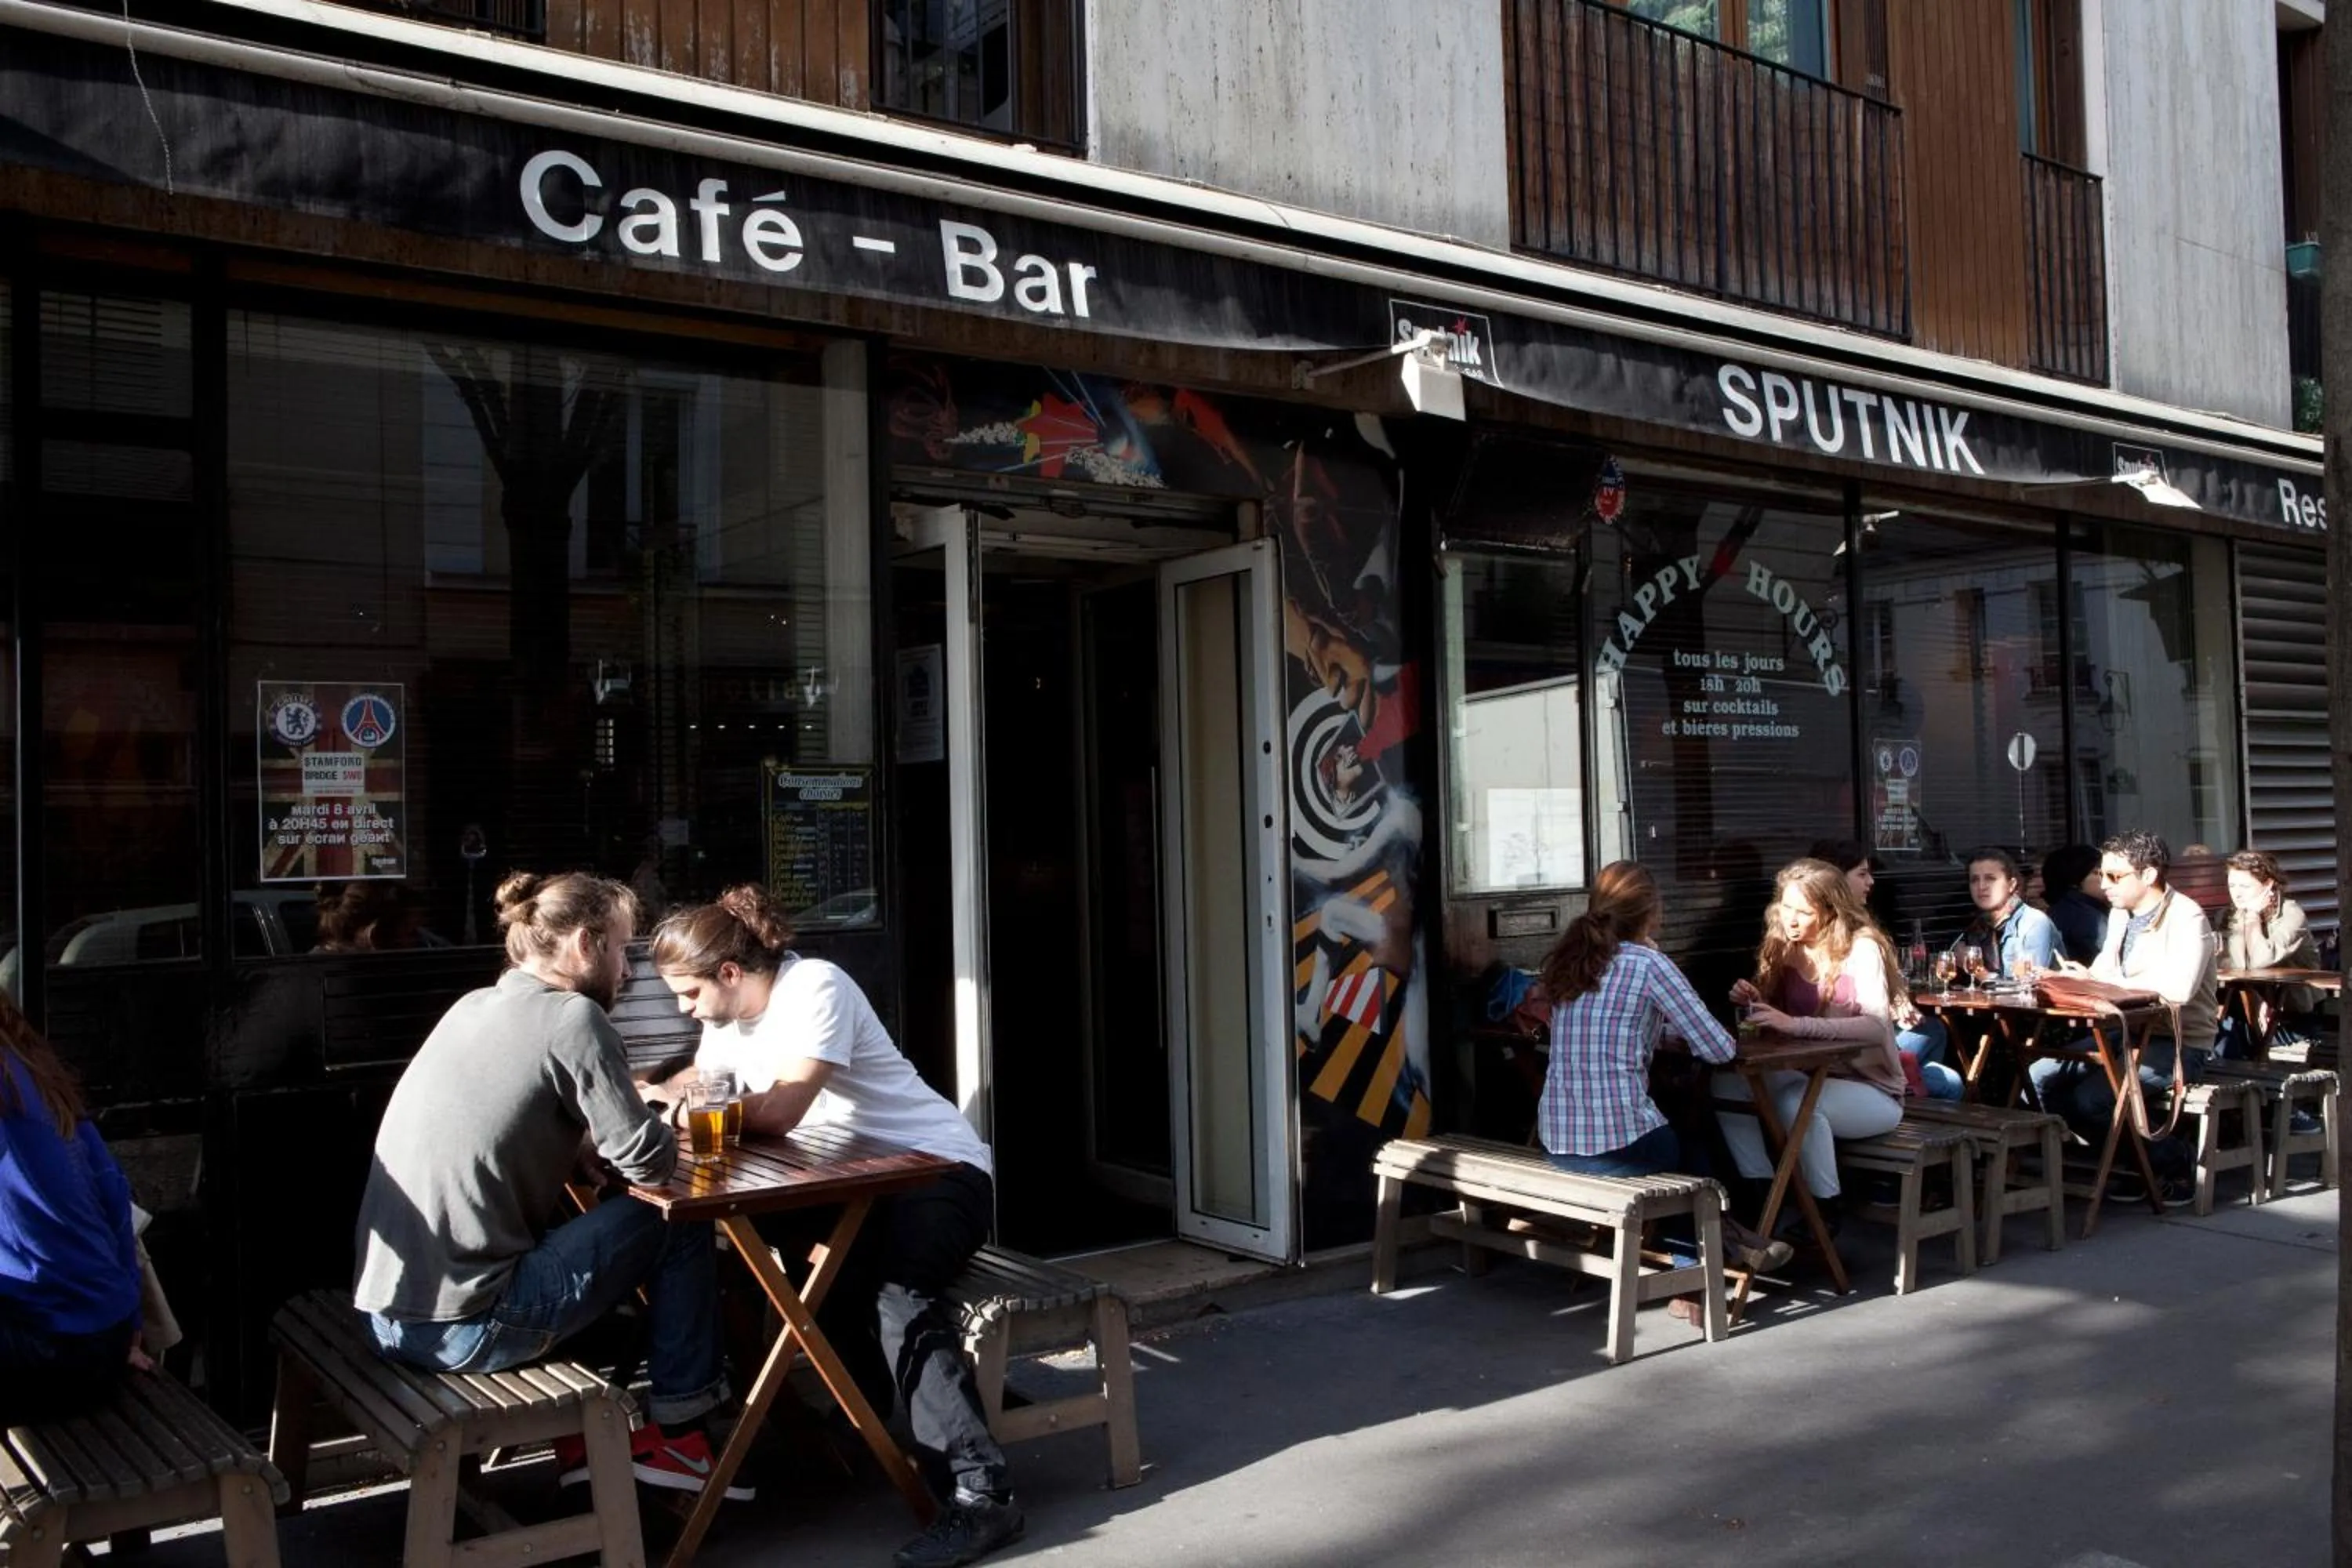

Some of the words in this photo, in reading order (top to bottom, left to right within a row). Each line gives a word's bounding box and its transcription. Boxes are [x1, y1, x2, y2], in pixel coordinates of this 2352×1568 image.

[520, 150, 804, 272] Café
[939, 219, 1097, 318] Bar
[1718, 364, 1985, 474] SPUTNIK
[1596, 555, 1701, 670] HAPPY
[1745, 560, 1846, 696] HOURS
[1673, 648, 1710, 667] tous
[1715, 650, 1738, 670] les
[1743, 652, 1785, 674] jours
[1736, 677, 1761, 693] 20h
[1683, 699, 1708, 713] sur
[1713, 698, 1779, 715] cocktails
[1661, 720, 1677, 735] et
[1682, 718, 1728, 736] bières
[1732, 720, 1800, 740] pressions
[304, 757, 362, 767] STAMFORD
[304, 771, 338, 781] BRIDGE
[347, 803, 376, 815] avril
[281, 818, 327, 830] 20H45
[353, 817, 394, 829] direct
[278, 833, 302, 845] sur
